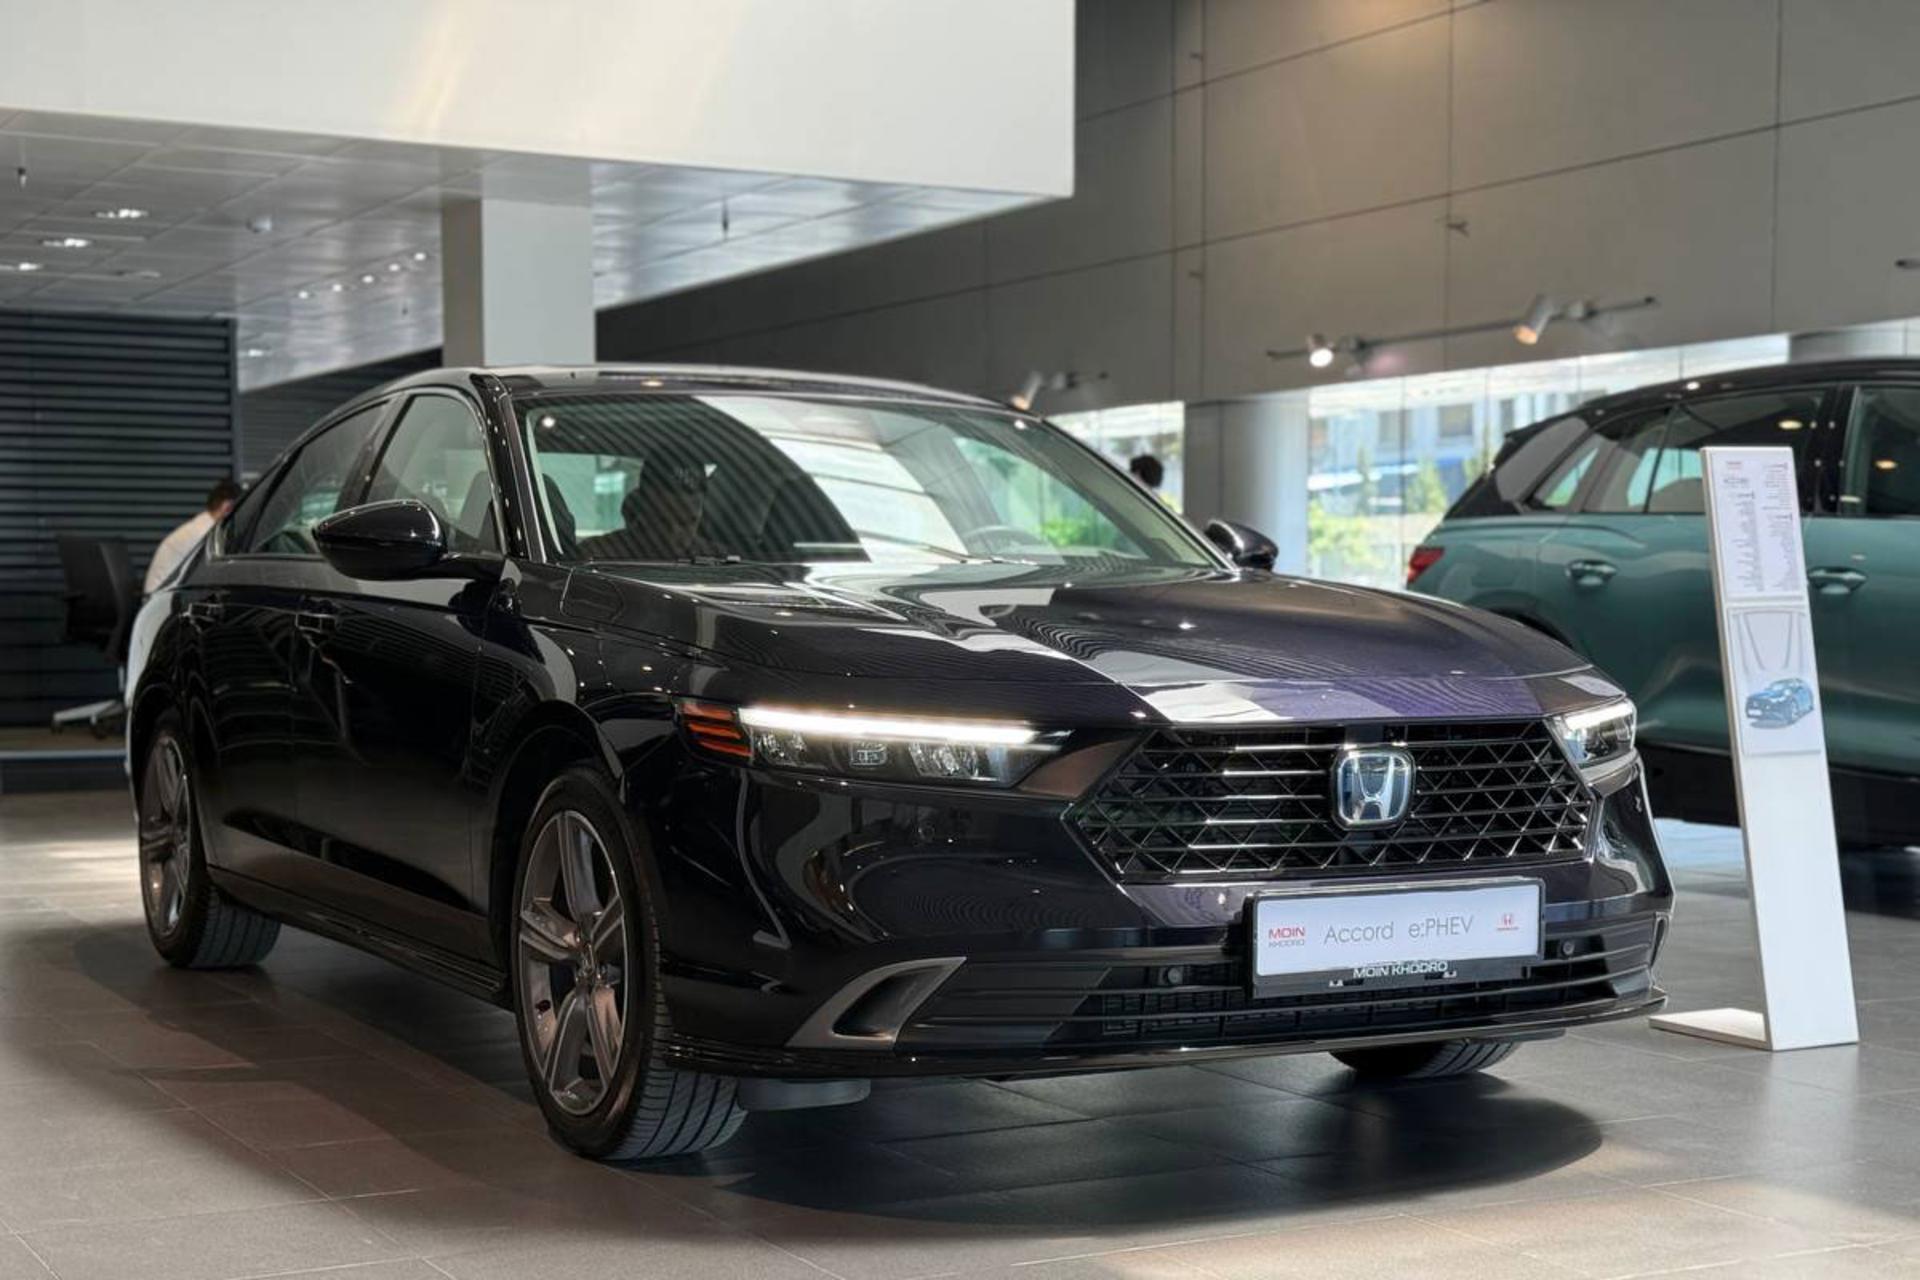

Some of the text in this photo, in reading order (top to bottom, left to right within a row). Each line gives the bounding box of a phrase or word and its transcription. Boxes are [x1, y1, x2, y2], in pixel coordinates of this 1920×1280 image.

[1268, 927, 1305, 939] MOIN
[1323, 915, 1474, 945] Accord e:PHEV
[1353, 961, 1448, 979] MOIN KHODRO
